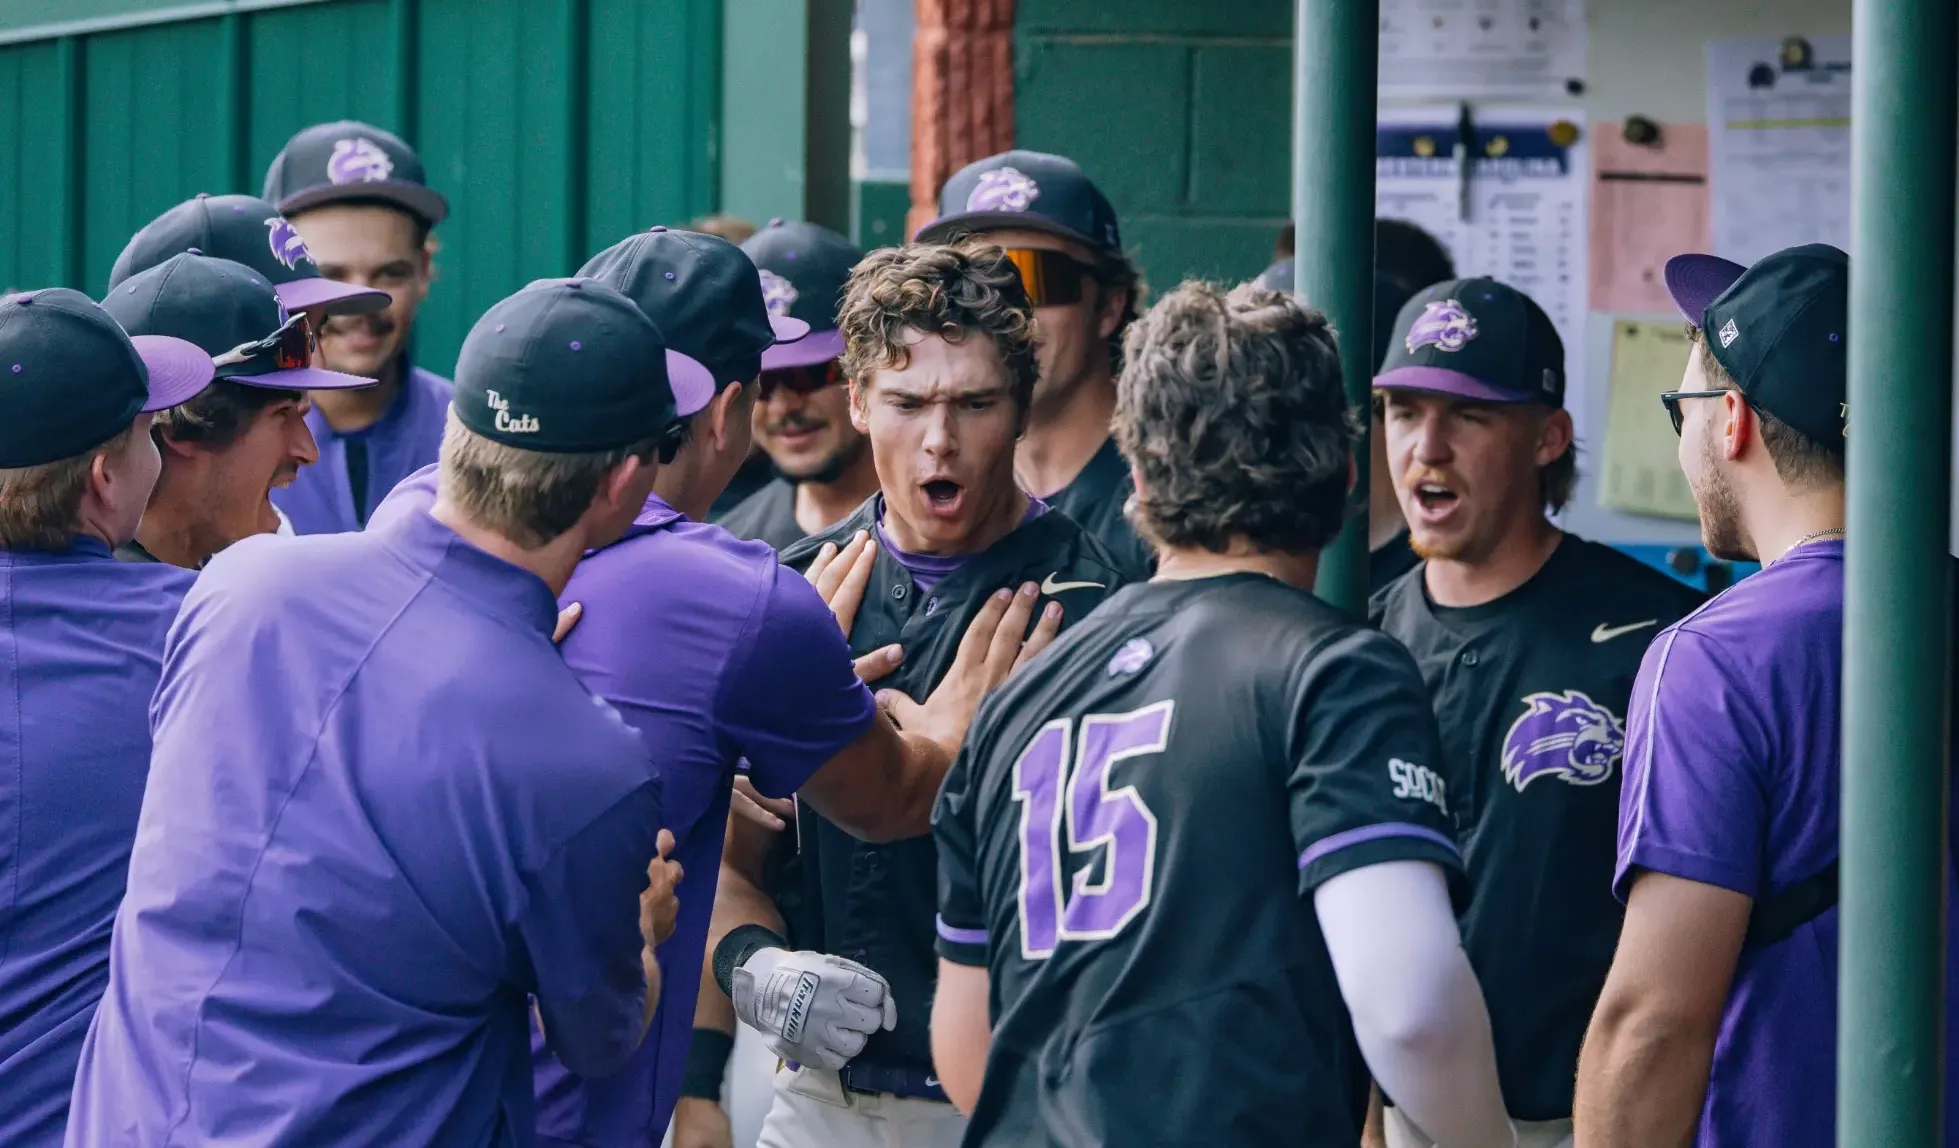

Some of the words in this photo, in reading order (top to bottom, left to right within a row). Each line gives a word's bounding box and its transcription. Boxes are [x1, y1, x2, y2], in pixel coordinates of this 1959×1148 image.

[486, 389, 510, 410] The
[495, 410, 540, 432] Cats
[1012, 700, 1175, 960] 15
